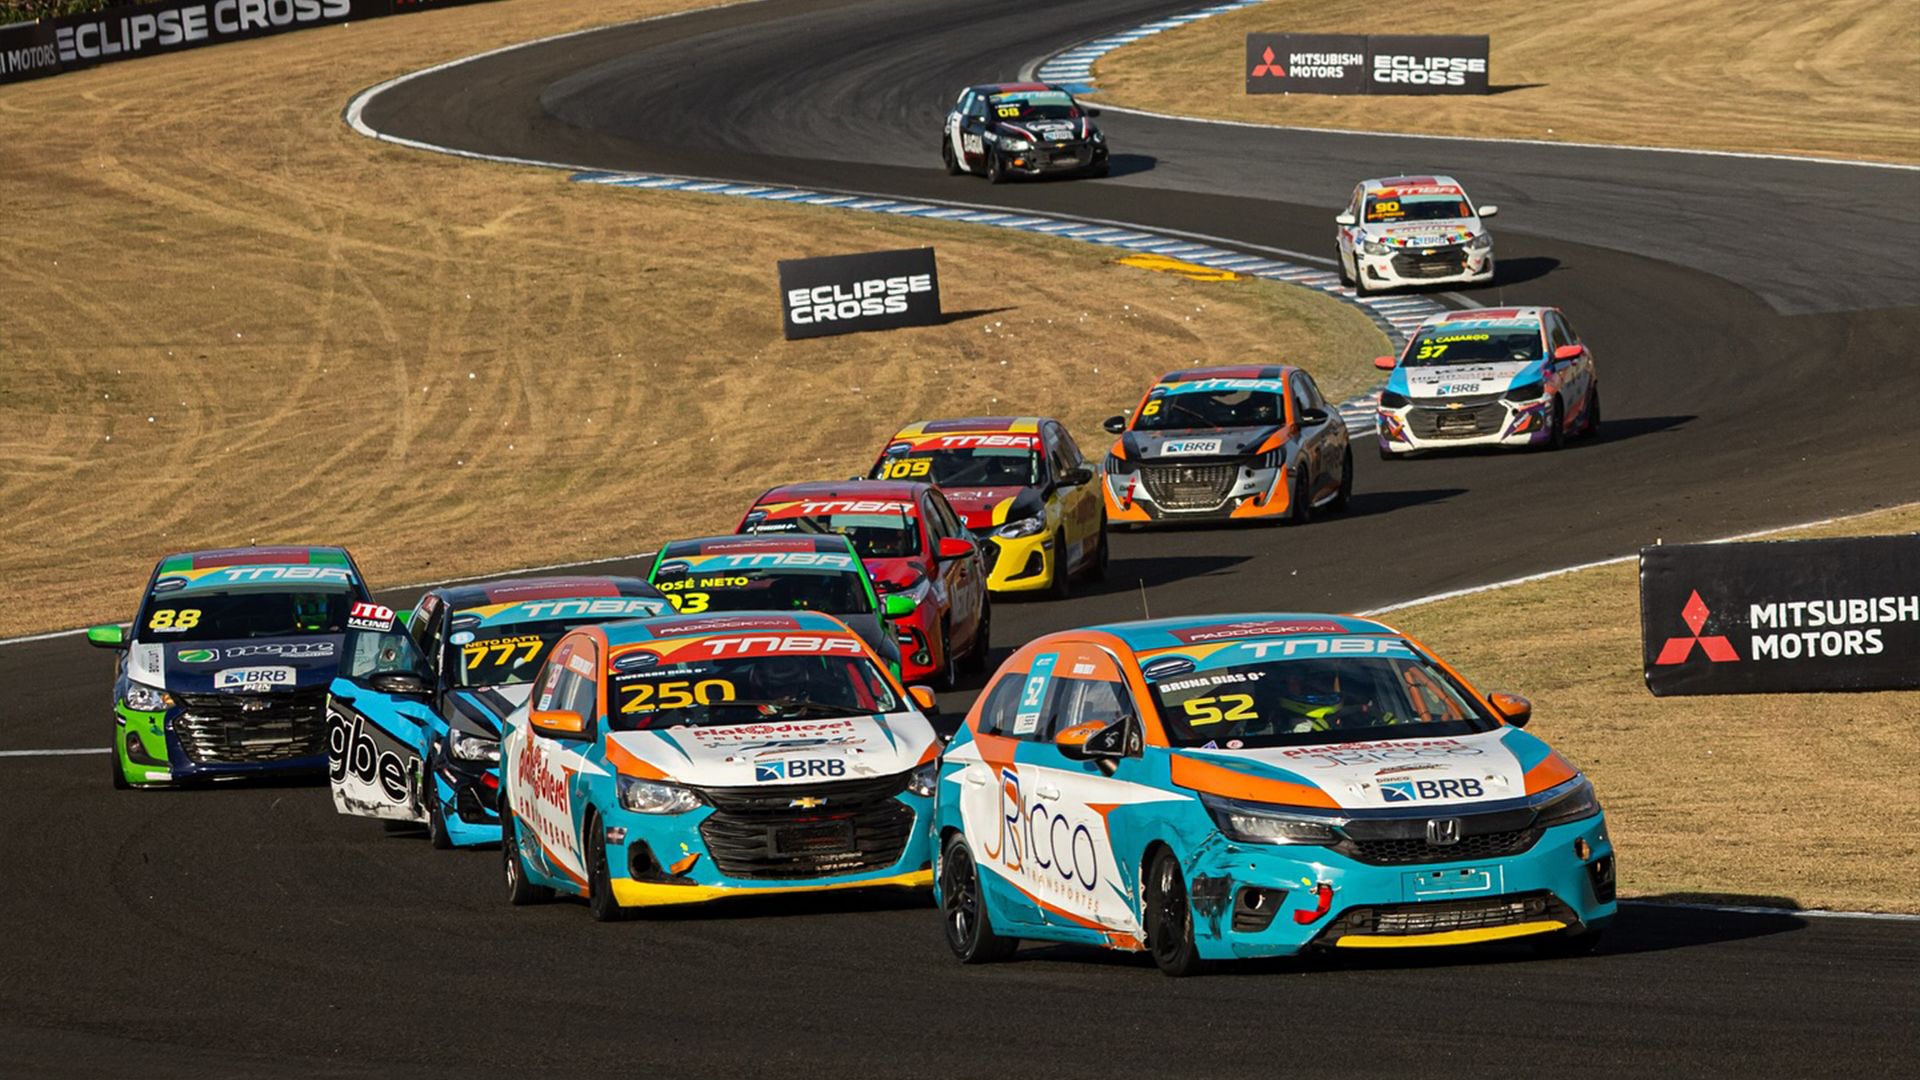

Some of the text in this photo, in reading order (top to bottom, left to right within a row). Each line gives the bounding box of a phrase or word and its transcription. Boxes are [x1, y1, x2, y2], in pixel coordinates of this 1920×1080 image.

[56, 0, 350, 61] ECLIPSE CROSS
[8, 44, 56, 73] MOTORS
[1290, 53, 1363, 66] MITSUBISHI
[1374, 55, 1486, 73] ECLIPSE
[1290, 65, 1344, 78] MOTORS
[1374, 69, 1465, 86] CROSS
[998, 107, 1020, 118] 08
[1375, 202, 1399, 213] 90
[788, 274, 932, 307] ECLIPSE
[790, 295, 908, 324] CROSS
[1435, 333, 1490, 344] CAMARGO
[1416, 345, 1448, 360] 37
[1450, 383, 1480, 394] BRB
[1142, 400, 1162, 416] 6
[1182, 441, 1218, 452] BRB
[882, 461, 931, 480] 109
[700, 576, 748, 587] NETO
[149, 609, 202, 629] 88
[1750, 596, 1919, 629] MITSUBISH
[660, 620, 790, 635] PADDOCKFAN
[1190, 625, 1336, 641] PADDOCKFAN
[465, 635, 540, 649] NETO DATTI
[1752, 629, 1884, 660] MOTORS
[463, 641, 544, 670] 777
[246, 670, 287, 682] BRB
[668, 669, 693, 677] DIAS
[1160, 679, 1210, 693] BRUNA
[1211, 673, 1247, 685] DIAS
[620, 679, 736, 714] 250
[1183, 693, 1259, 726] 52
[788, 759, 846, 778] BRB
[1416, 778, 1484, 799] BRB
